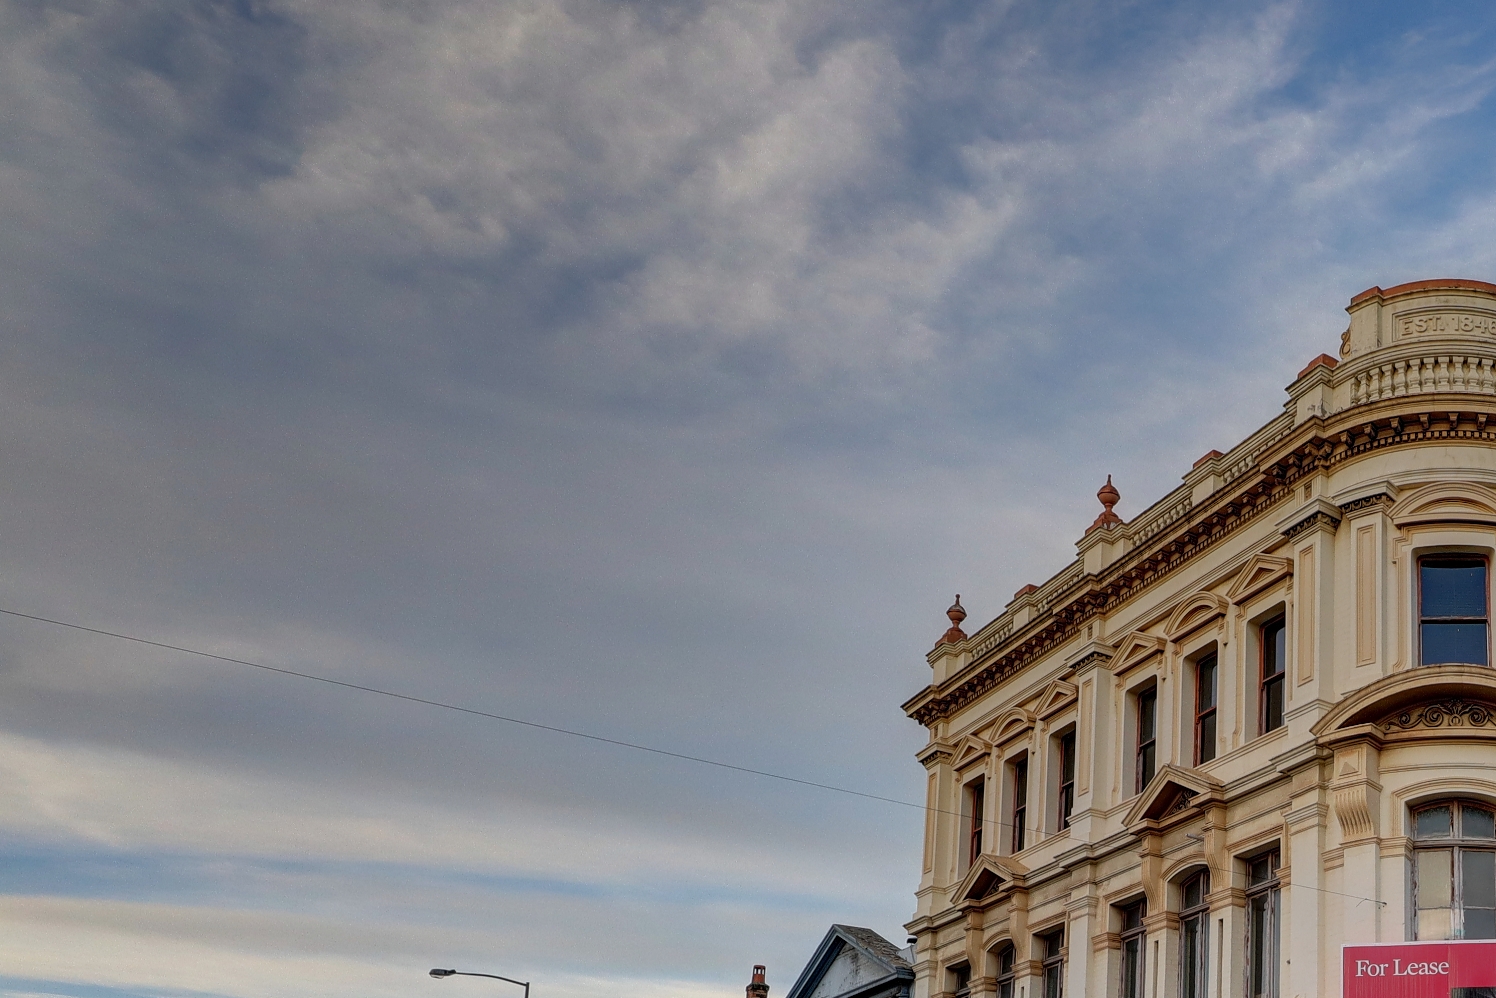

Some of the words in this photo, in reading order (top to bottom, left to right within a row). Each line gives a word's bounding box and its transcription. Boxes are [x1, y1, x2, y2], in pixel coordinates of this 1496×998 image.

[1401, 315, 1444, 336] EST.
[1355, 959, 1389, 977] For
[1392, 958, 1450, 976] Lease
